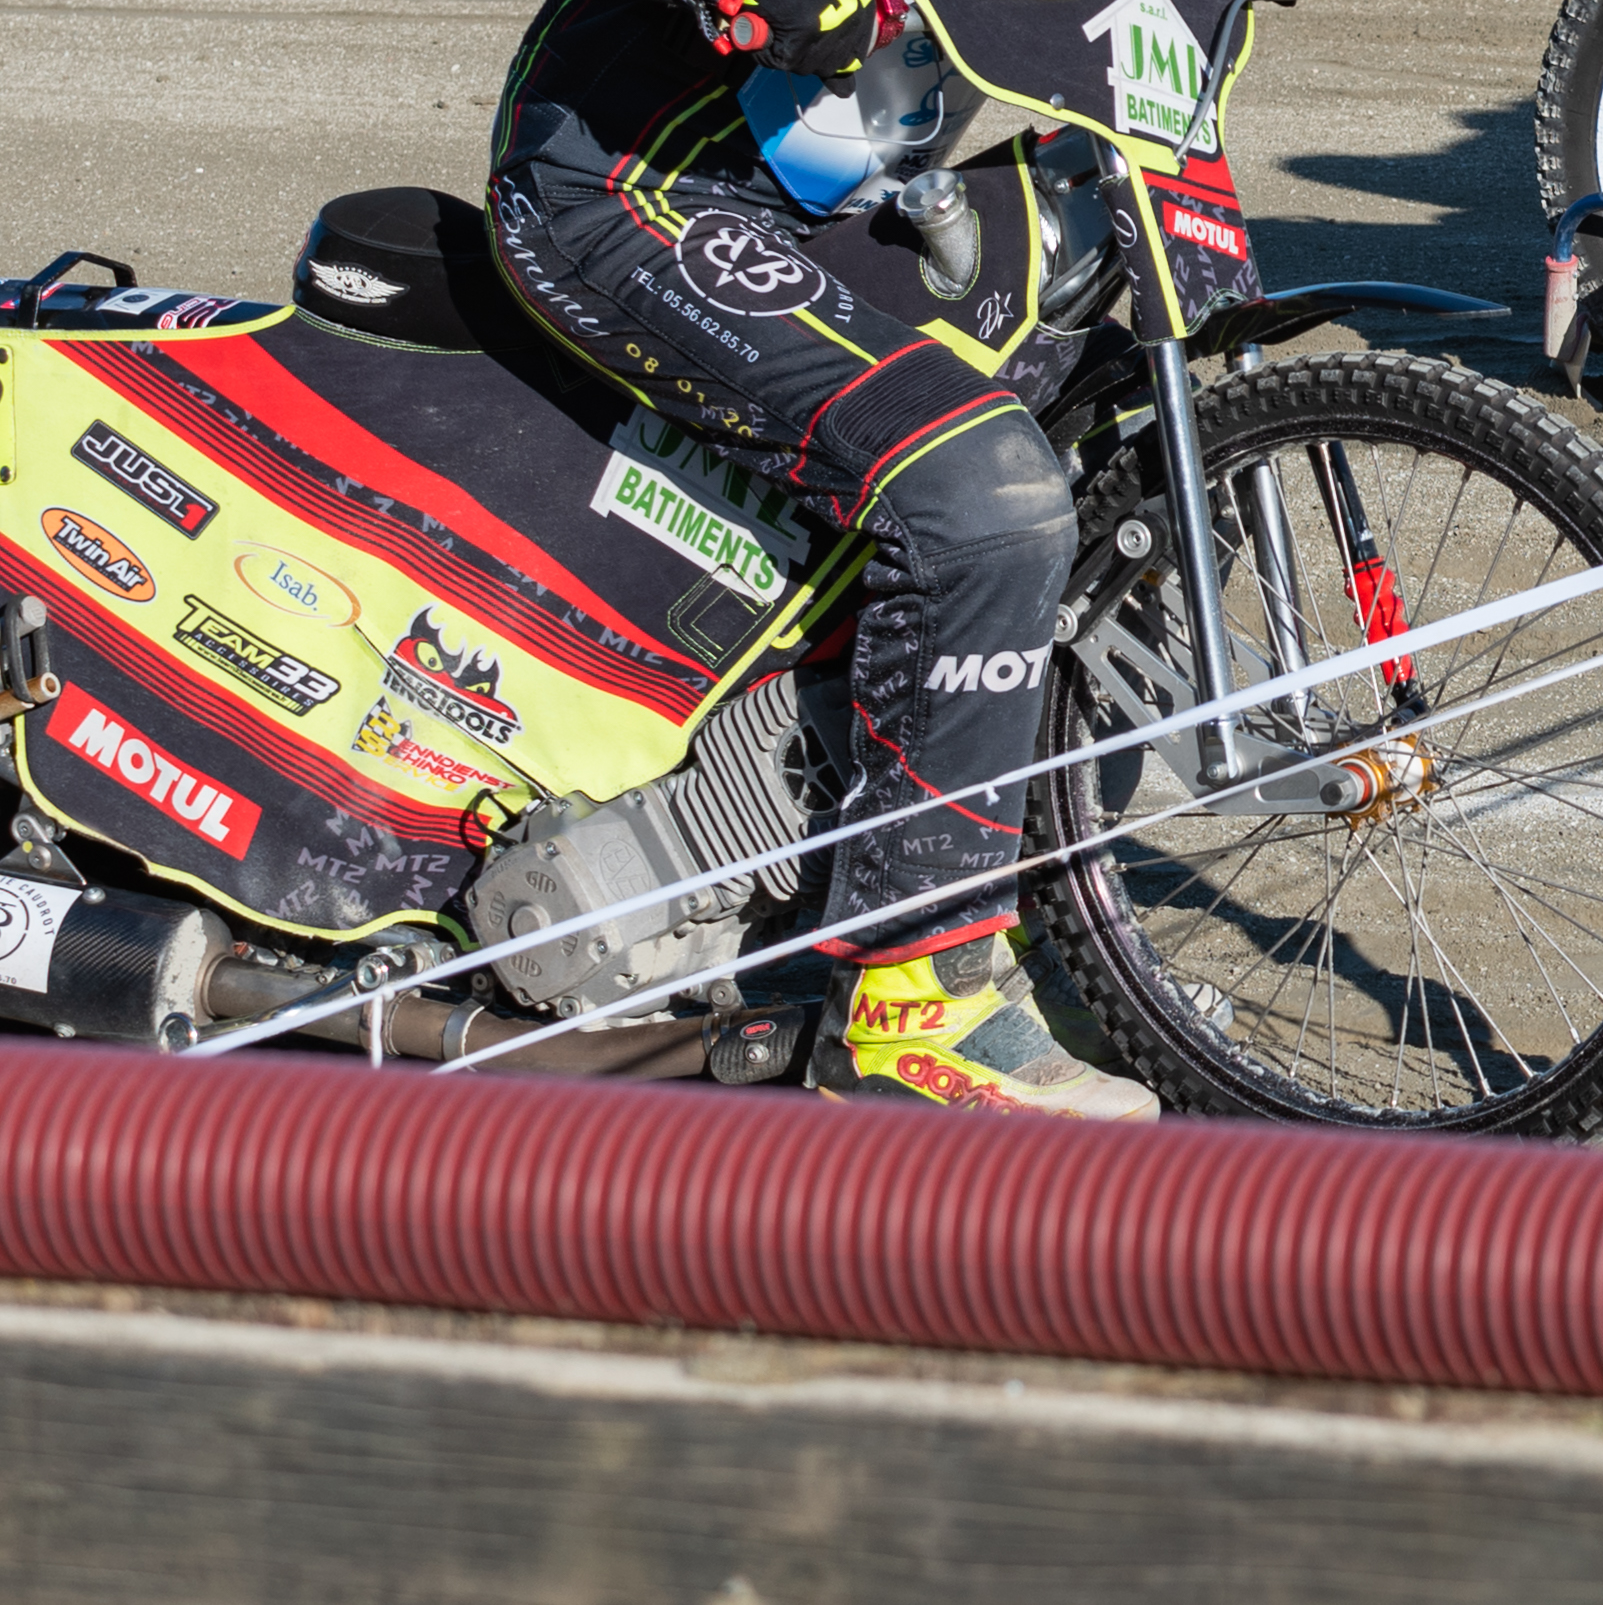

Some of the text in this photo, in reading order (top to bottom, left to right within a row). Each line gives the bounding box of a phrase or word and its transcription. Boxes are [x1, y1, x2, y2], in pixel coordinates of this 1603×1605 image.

[1173, 210, 1239, 256] MOTUL
[629, 264, 760, 365] TEL: 05.56.62.85.70
[80, 432, 214, 533] JUST1
[60, 515, 110, 569] Twin
[107, 554, 147, 594] Air
[614, 465, 776, 591] BATIMENTS
[268, 559, 321, 612] Isab.
[68, 707, 233, 843] MOTUL
[298, 846, 366, 885] MT2
[374, 853, 450, 874] MT2
[903, 833, 954, 857] MT2
[960, 850, 1006, 869] MT2
[18, 883, 56, 936] CAUDROT
[853, 992, 947, 1034] MT2
